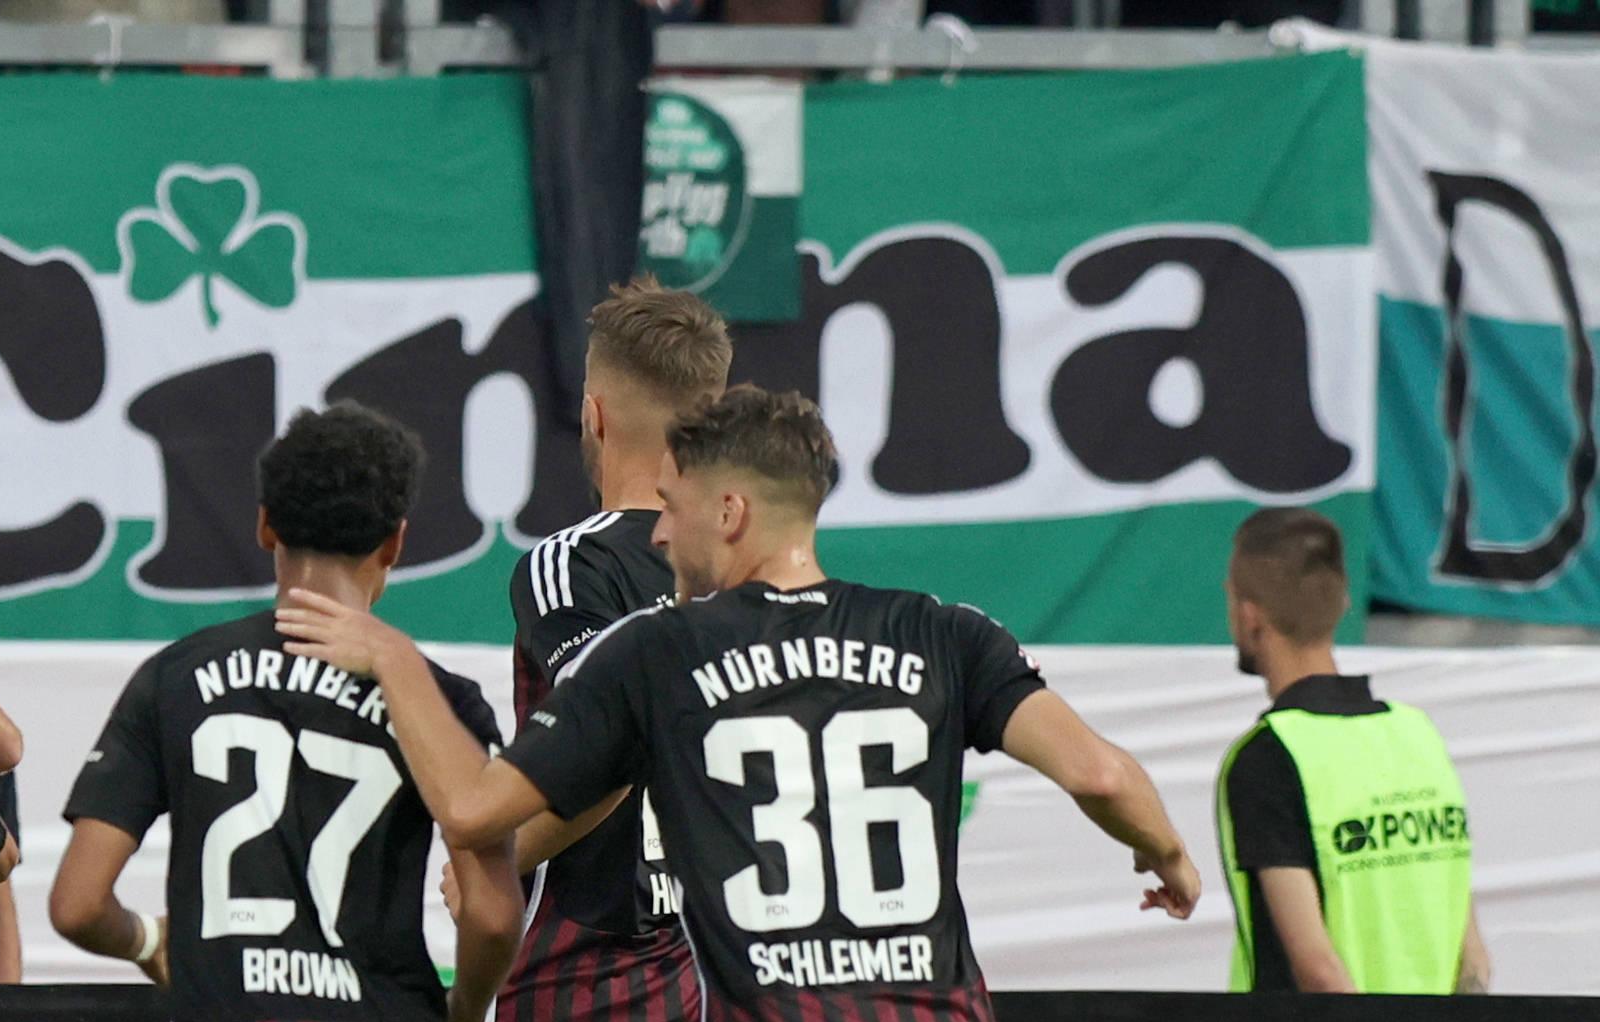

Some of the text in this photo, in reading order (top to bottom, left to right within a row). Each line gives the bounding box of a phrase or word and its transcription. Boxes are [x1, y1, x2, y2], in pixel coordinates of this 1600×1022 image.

[194, 648, 399, 735] NÜRNBER
[691, 636, 926, 708] NÜRNBERG
[191, 712, 403, 948] 27
[703, 707, 941, 933] 36
[242, 947, 361, 1002] BROWN
[748, 935, 933, 987] SCHLEIMER
